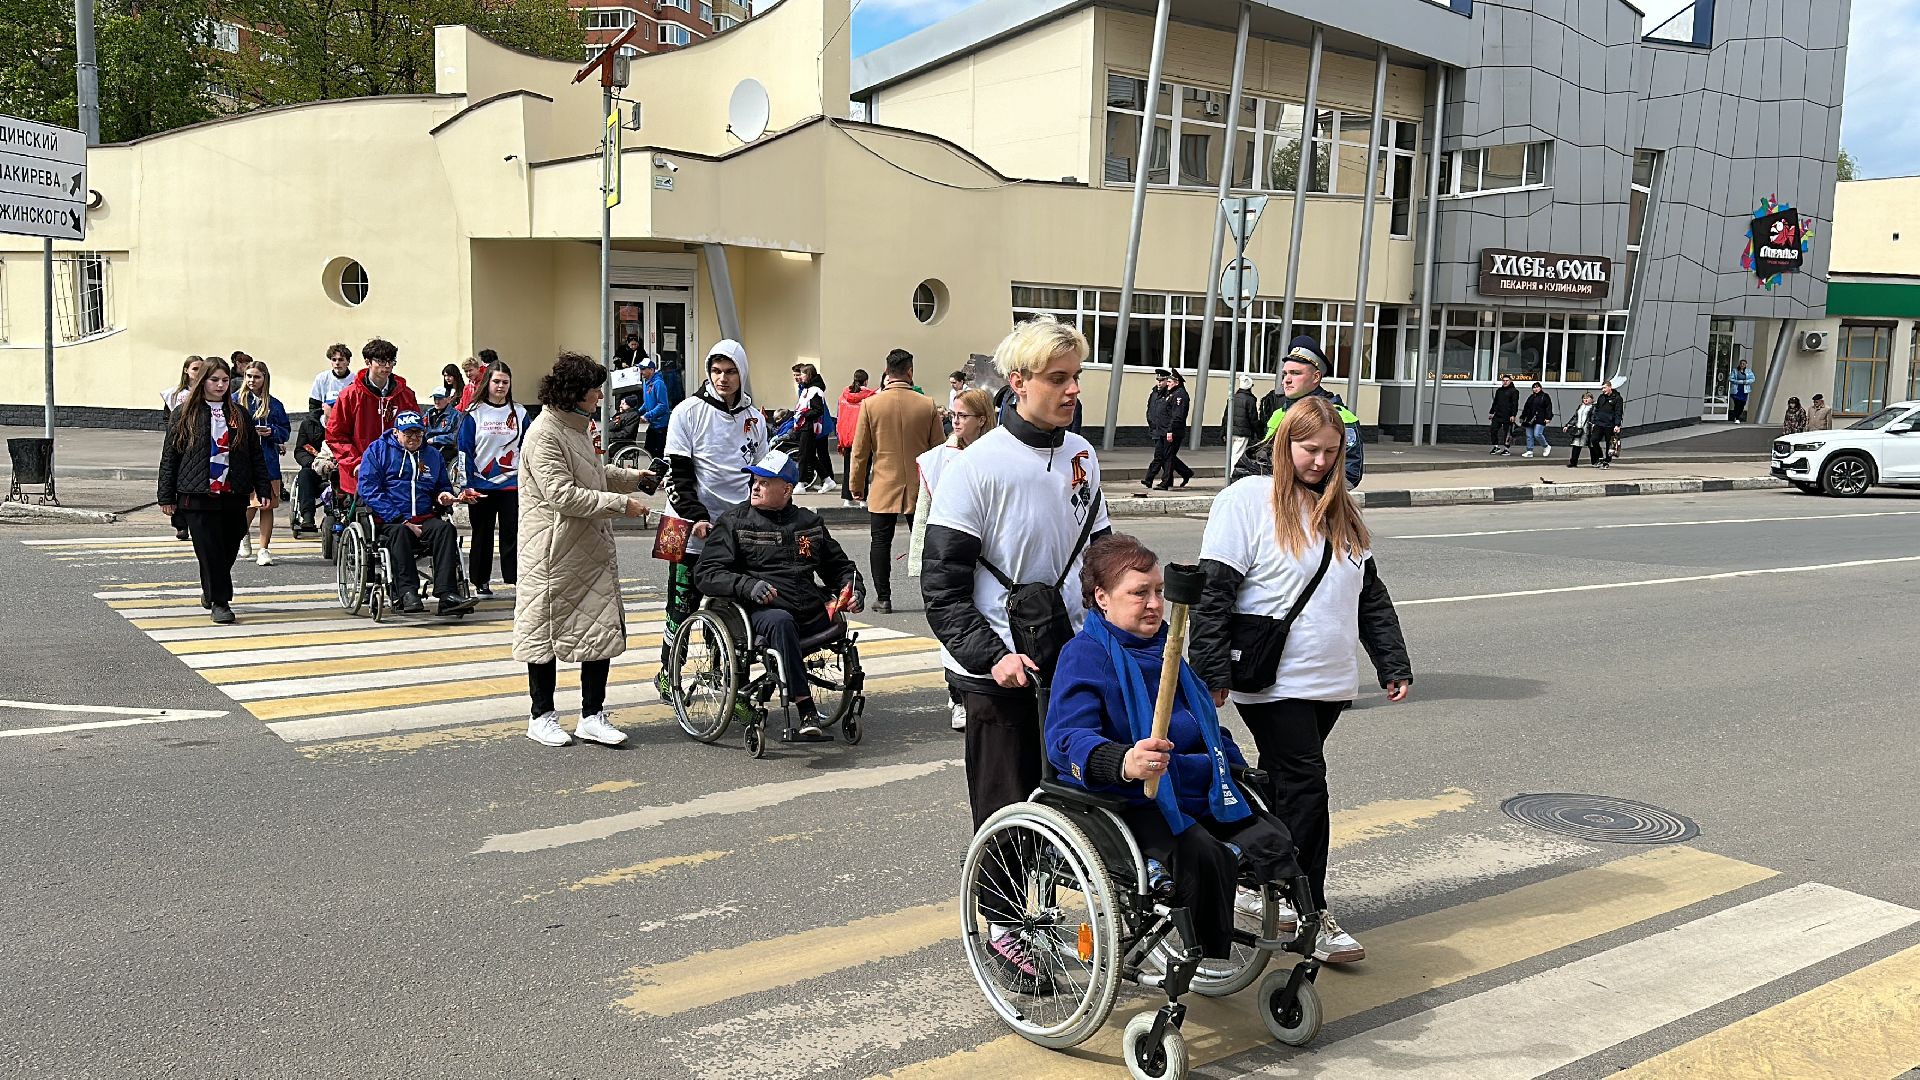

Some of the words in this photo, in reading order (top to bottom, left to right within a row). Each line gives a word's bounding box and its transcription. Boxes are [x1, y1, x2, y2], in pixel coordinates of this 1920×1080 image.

[0, 203, 68, 226] ЖИНСКОГО
[1489, 254, 1546, 278] ХЛЕБ
[1556, 259, 1606, 282] СОЛЬ
[1500, 279, 1538, 291] ПЕКАРНЯ
[1544, 282, 1593, 294] КУЛИНАРИЯ
